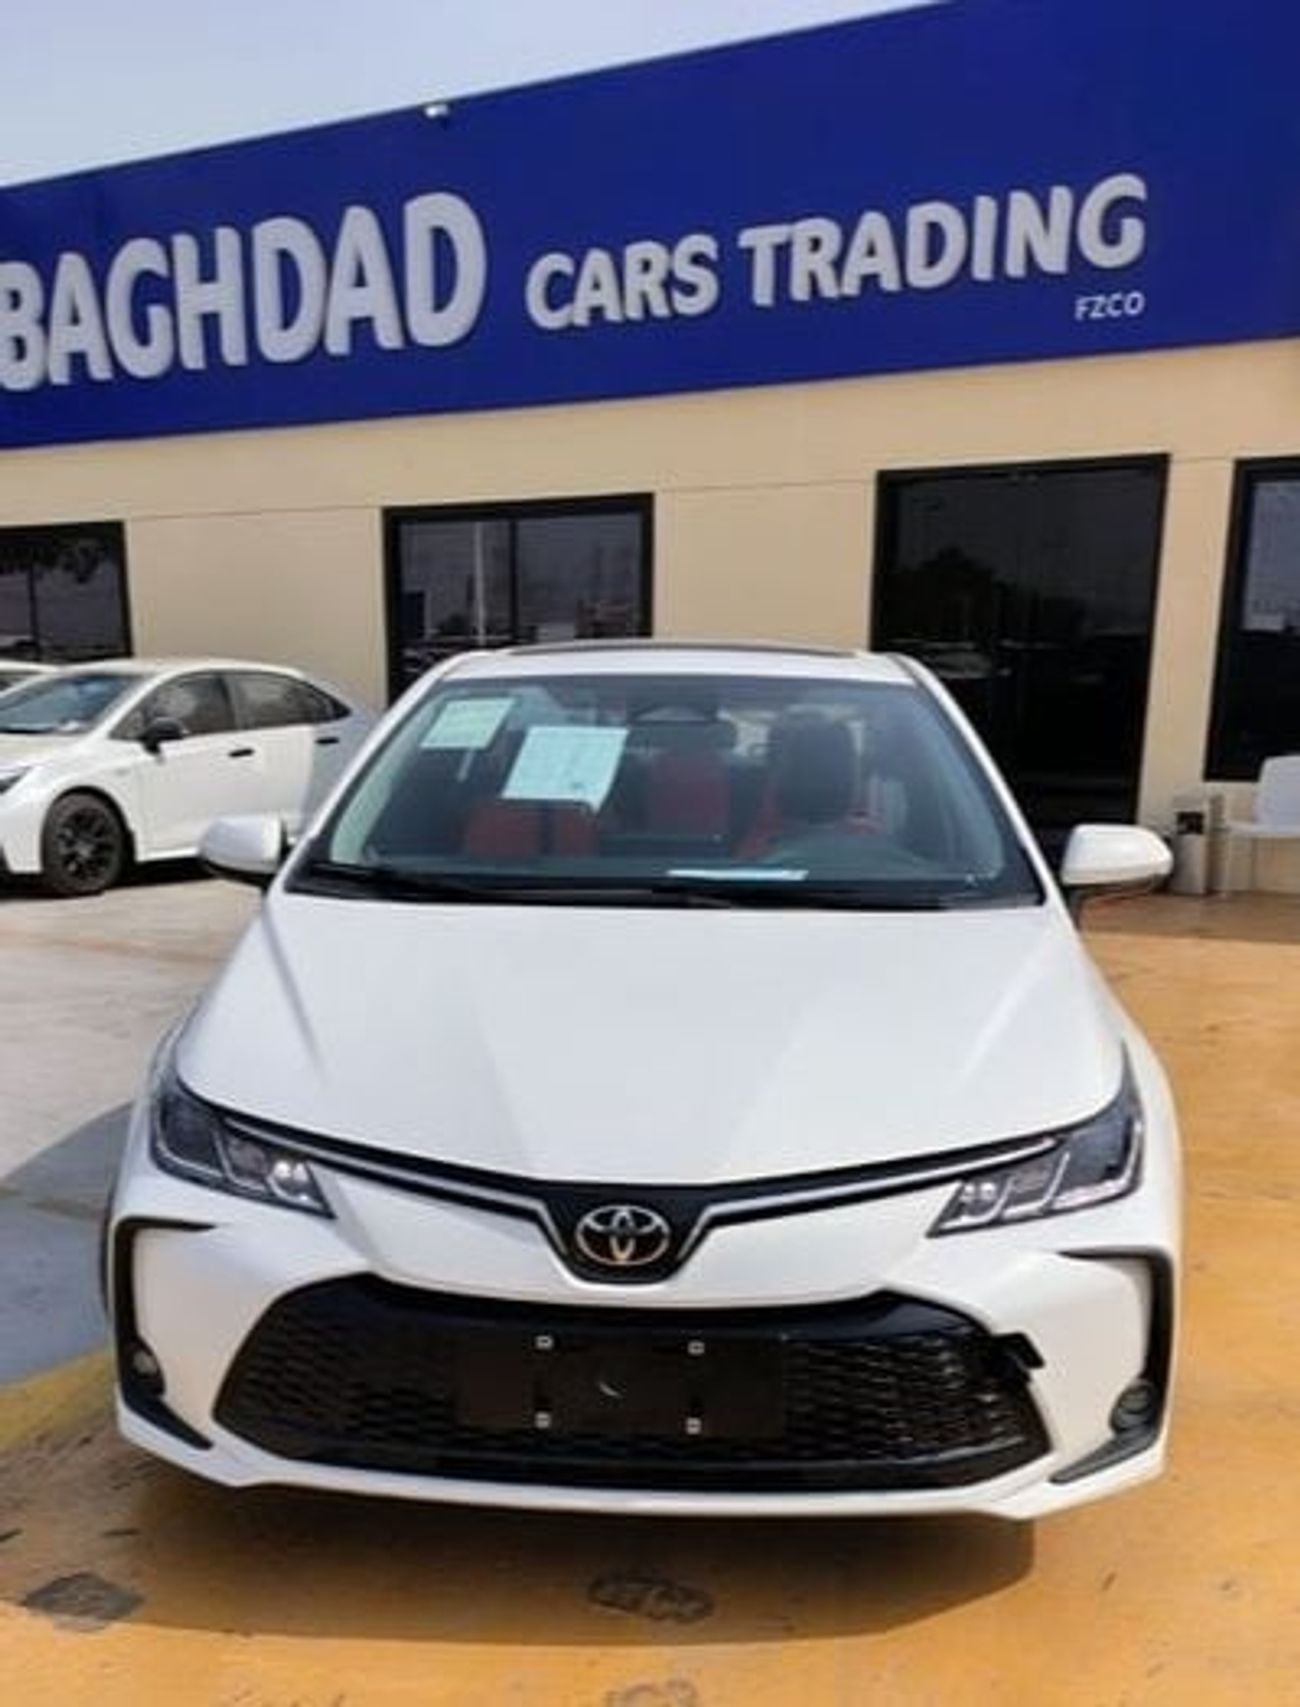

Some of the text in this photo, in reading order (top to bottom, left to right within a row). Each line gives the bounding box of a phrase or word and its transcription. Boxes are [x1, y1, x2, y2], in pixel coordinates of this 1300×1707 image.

[0, 173, 1147, 391] BAGHDAD CARS TRADING
[1075, 291, 1146, 321] FZCO
